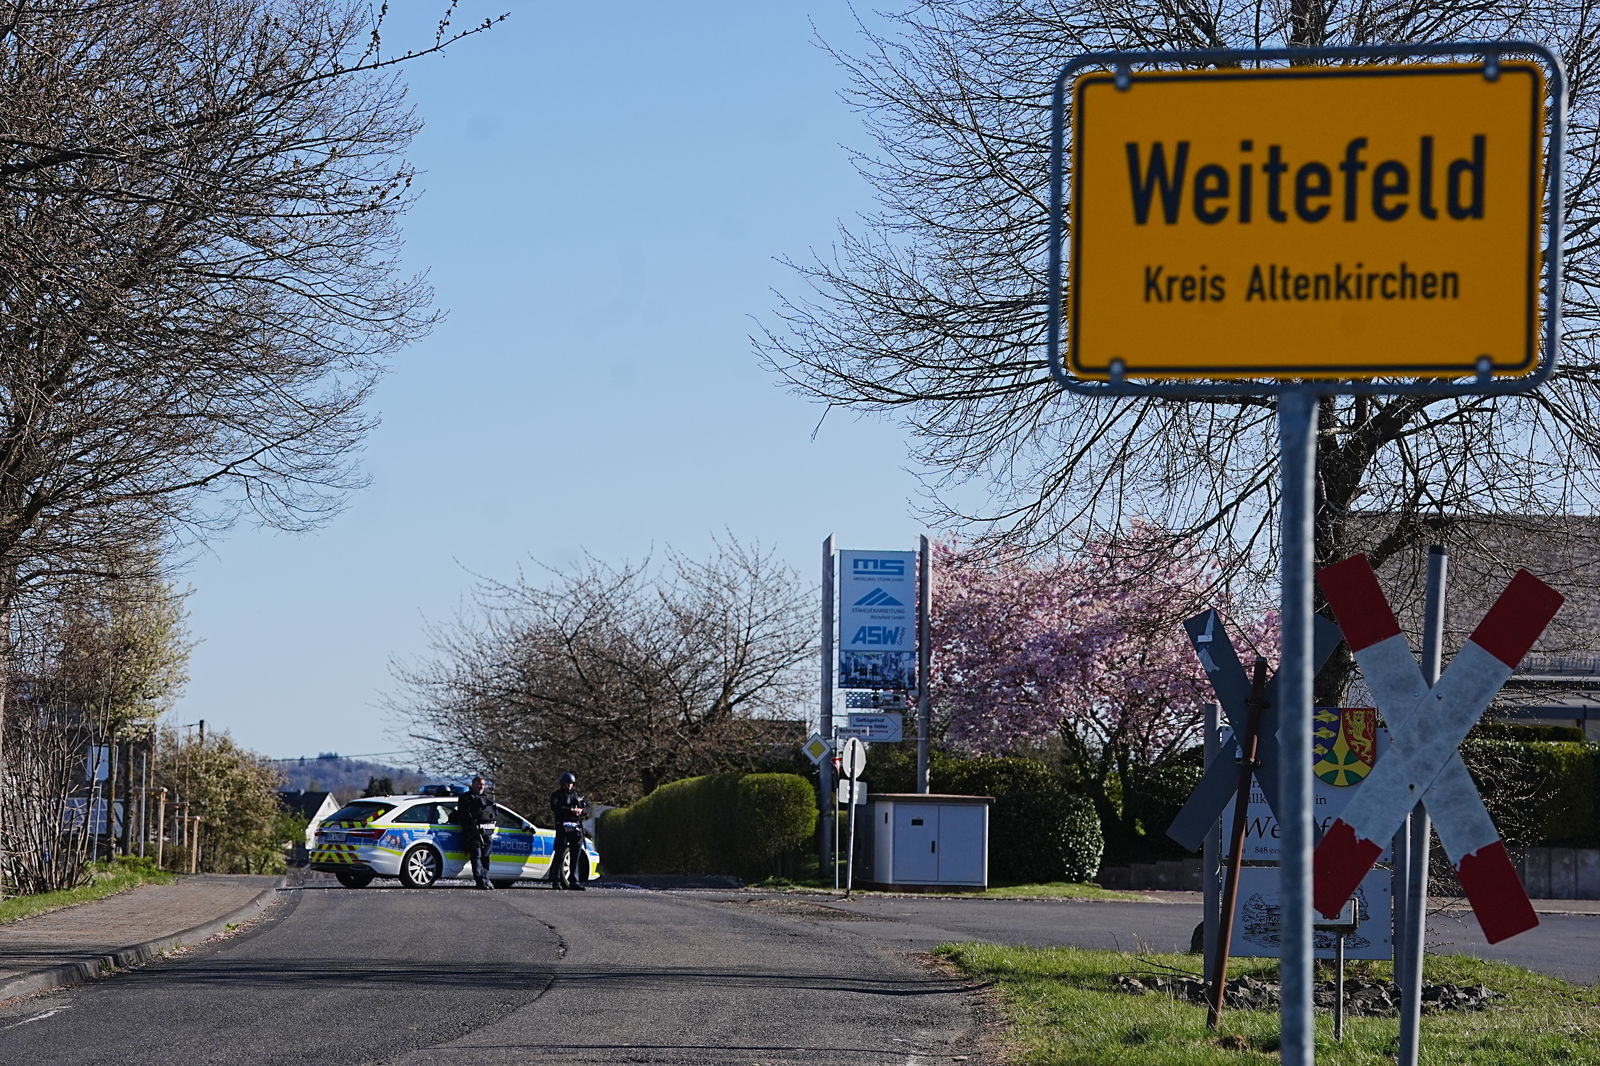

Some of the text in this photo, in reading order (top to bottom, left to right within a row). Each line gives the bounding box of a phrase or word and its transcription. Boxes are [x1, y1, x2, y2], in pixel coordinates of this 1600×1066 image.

[1125, 134, 1486, 226] Weitefeld
[1143, 262, 1459, 303] Kreis Altenkirchen
[851, 626, 900, 645] ASW
[1315, 794, 1327, 805] in
[500, 841, 530, 851] POLIZEI
